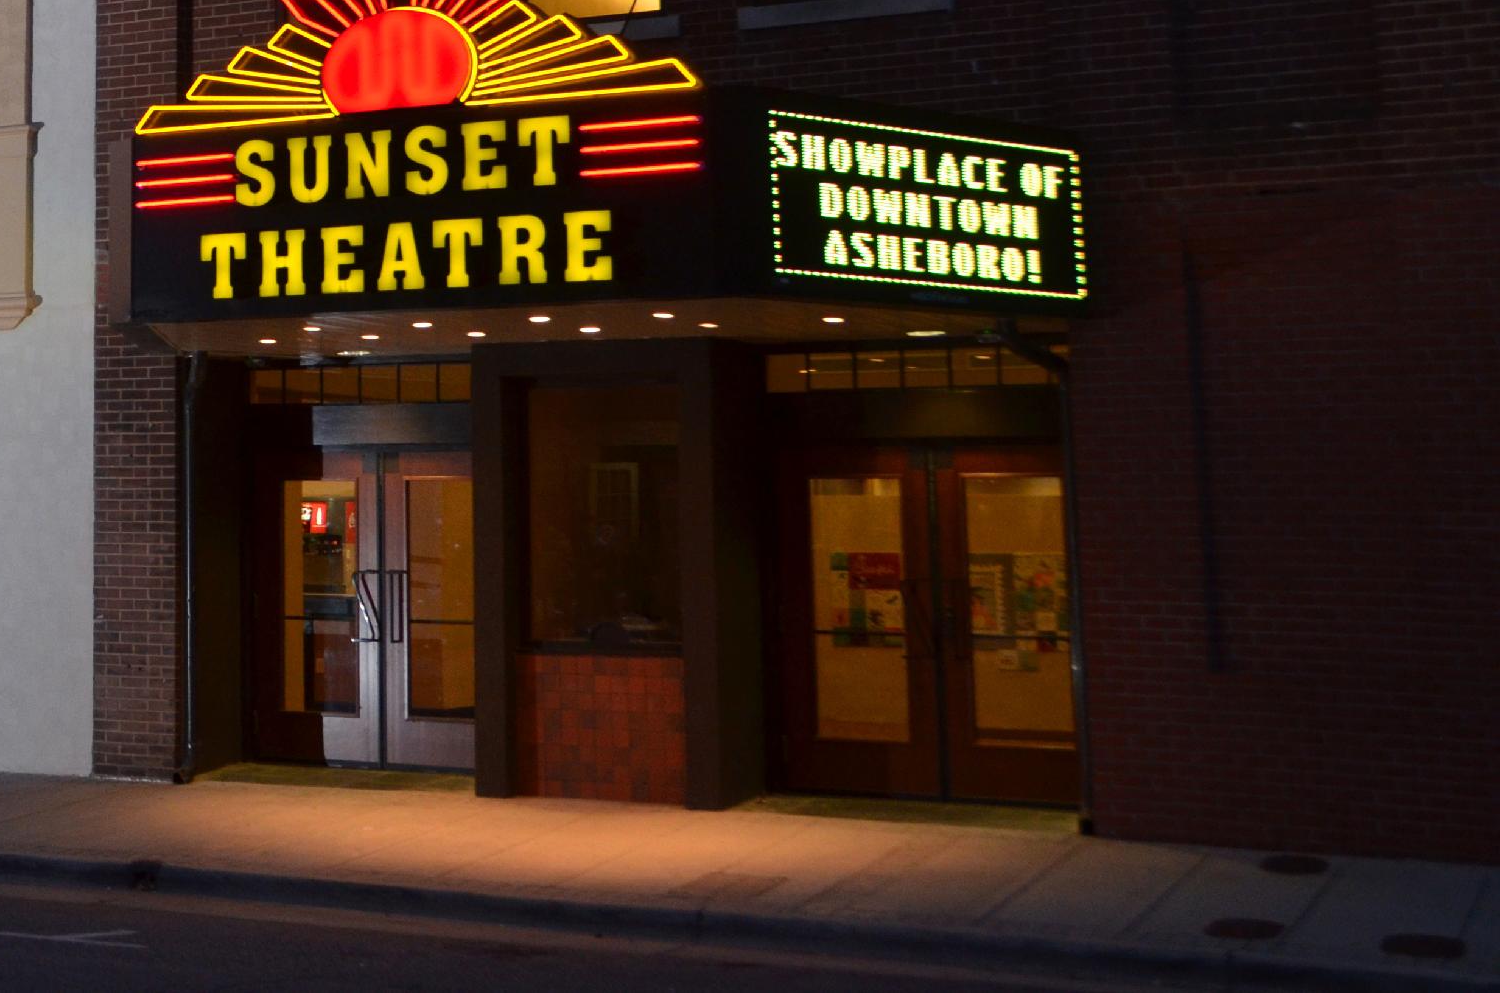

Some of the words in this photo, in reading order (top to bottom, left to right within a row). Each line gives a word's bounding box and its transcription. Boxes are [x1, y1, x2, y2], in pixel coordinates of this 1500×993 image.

[235, 116, 570, 207] SUNSET
[774, 131, 1008, 193] SHOWPLACE
[1020, 163, 1065, 199] OF
[819, 182, 1039, 240] DOWNTOWN
[201, 210, 613, 299] THEATRE
[824, 230, 1042, 284] ASHEBORO!
